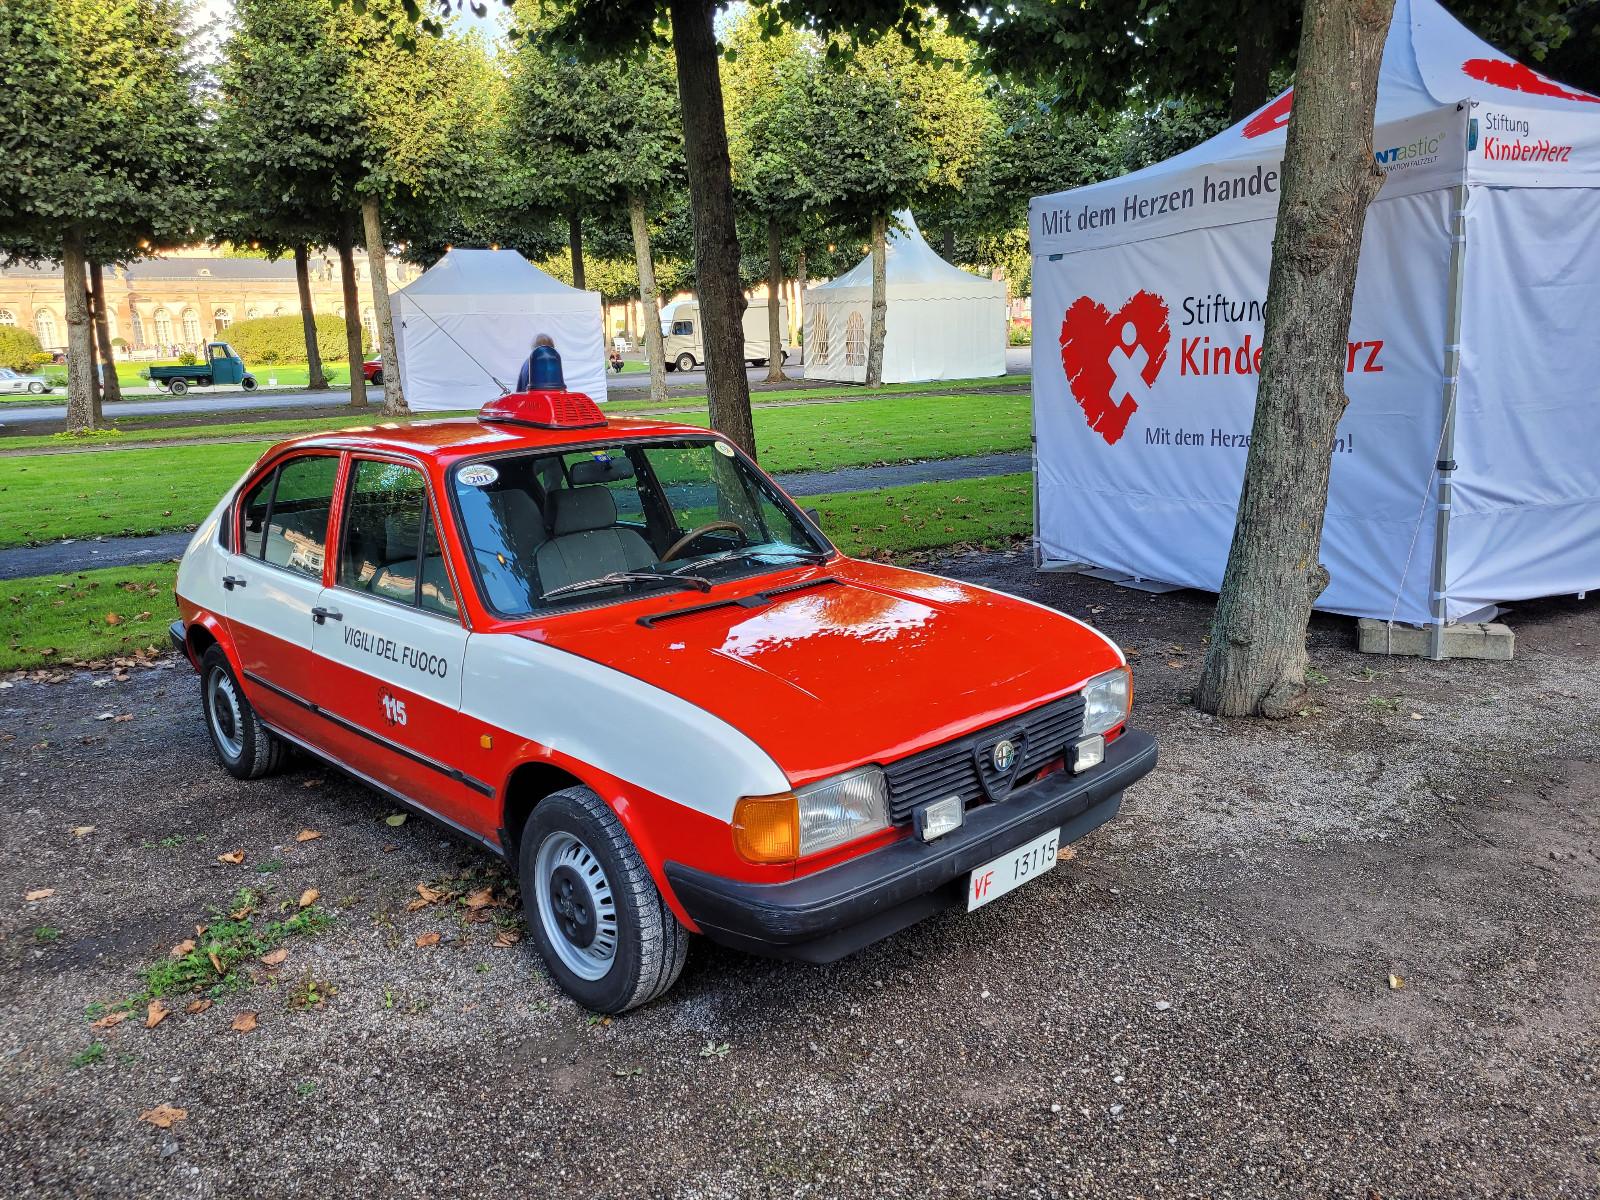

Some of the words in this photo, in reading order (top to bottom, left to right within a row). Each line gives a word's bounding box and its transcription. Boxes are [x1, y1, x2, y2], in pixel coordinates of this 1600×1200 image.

[1485, 112, 1530, 138] Stiftung
[1375, 136, 1439, 164] NTastic
[1483, 136, 1573, 163] KinderHerz
[1041, 209, 1072, 236] Mit
[1077, 205, 1116, 231] dem
[1123, 186, 1194, 222] Herzen
[1203, 165, 1278, 204] hande
[1145, 427, 1171, 446] Mit
[1174, 428, 1204, 446] dem
[1210, 428, 1251, 448] Herze
[344, 625, 375, 653] VIGILI
[376, 637, 399, 662] DEL
[401, 646, 448, 679] FUOCO
[382, 695, 407, 726] 115
[974, 871, 994, 901] VF
[1013, 838, 1057, 880] 13115
